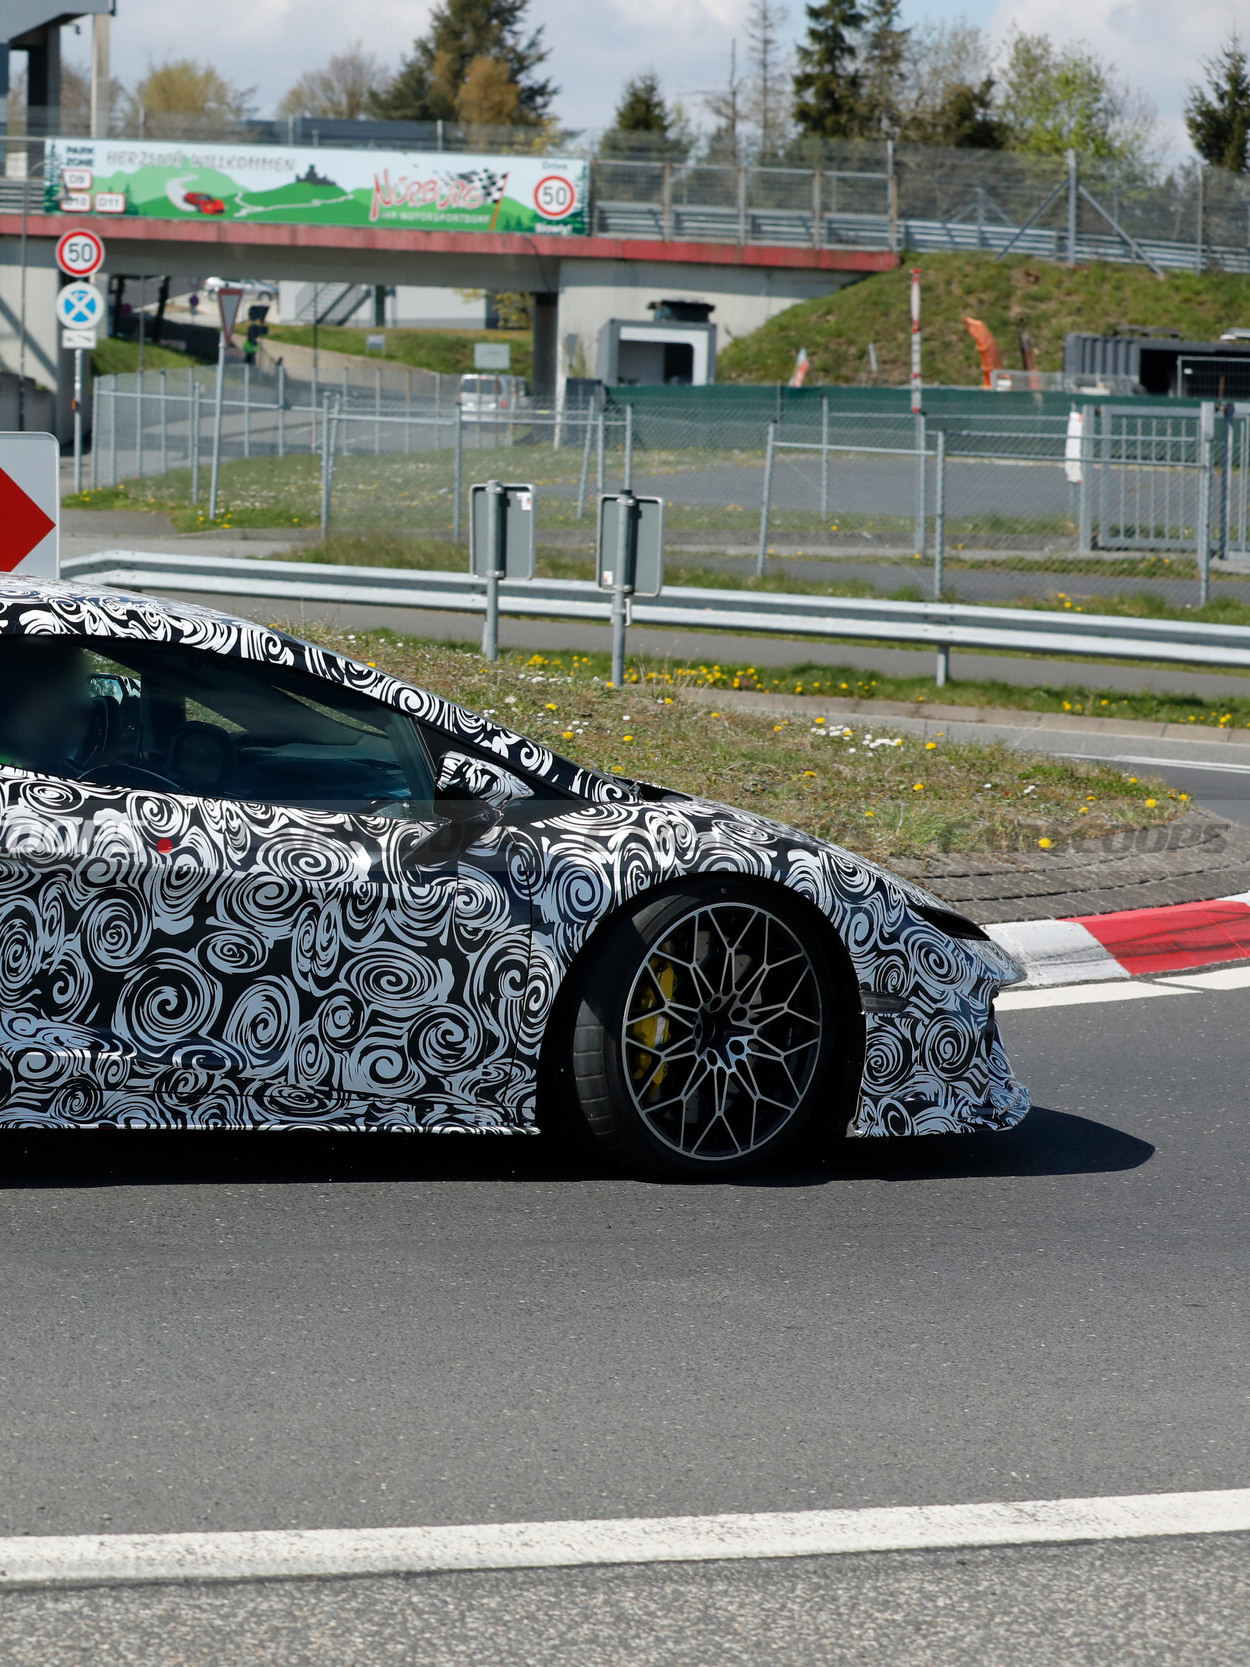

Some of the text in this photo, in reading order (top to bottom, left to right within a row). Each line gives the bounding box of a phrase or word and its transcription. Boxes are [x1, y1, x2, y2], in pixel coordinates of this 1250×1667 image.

[66, 146, 94, 155] PARK
[66, 158, 94, 167] ZONE
[191, 153, 296, 172] WILLKOMMEN
[98, 197, 120, 207] D11
[543, 186, 567, 206] 50
[68, 243, 93, 263] 50
